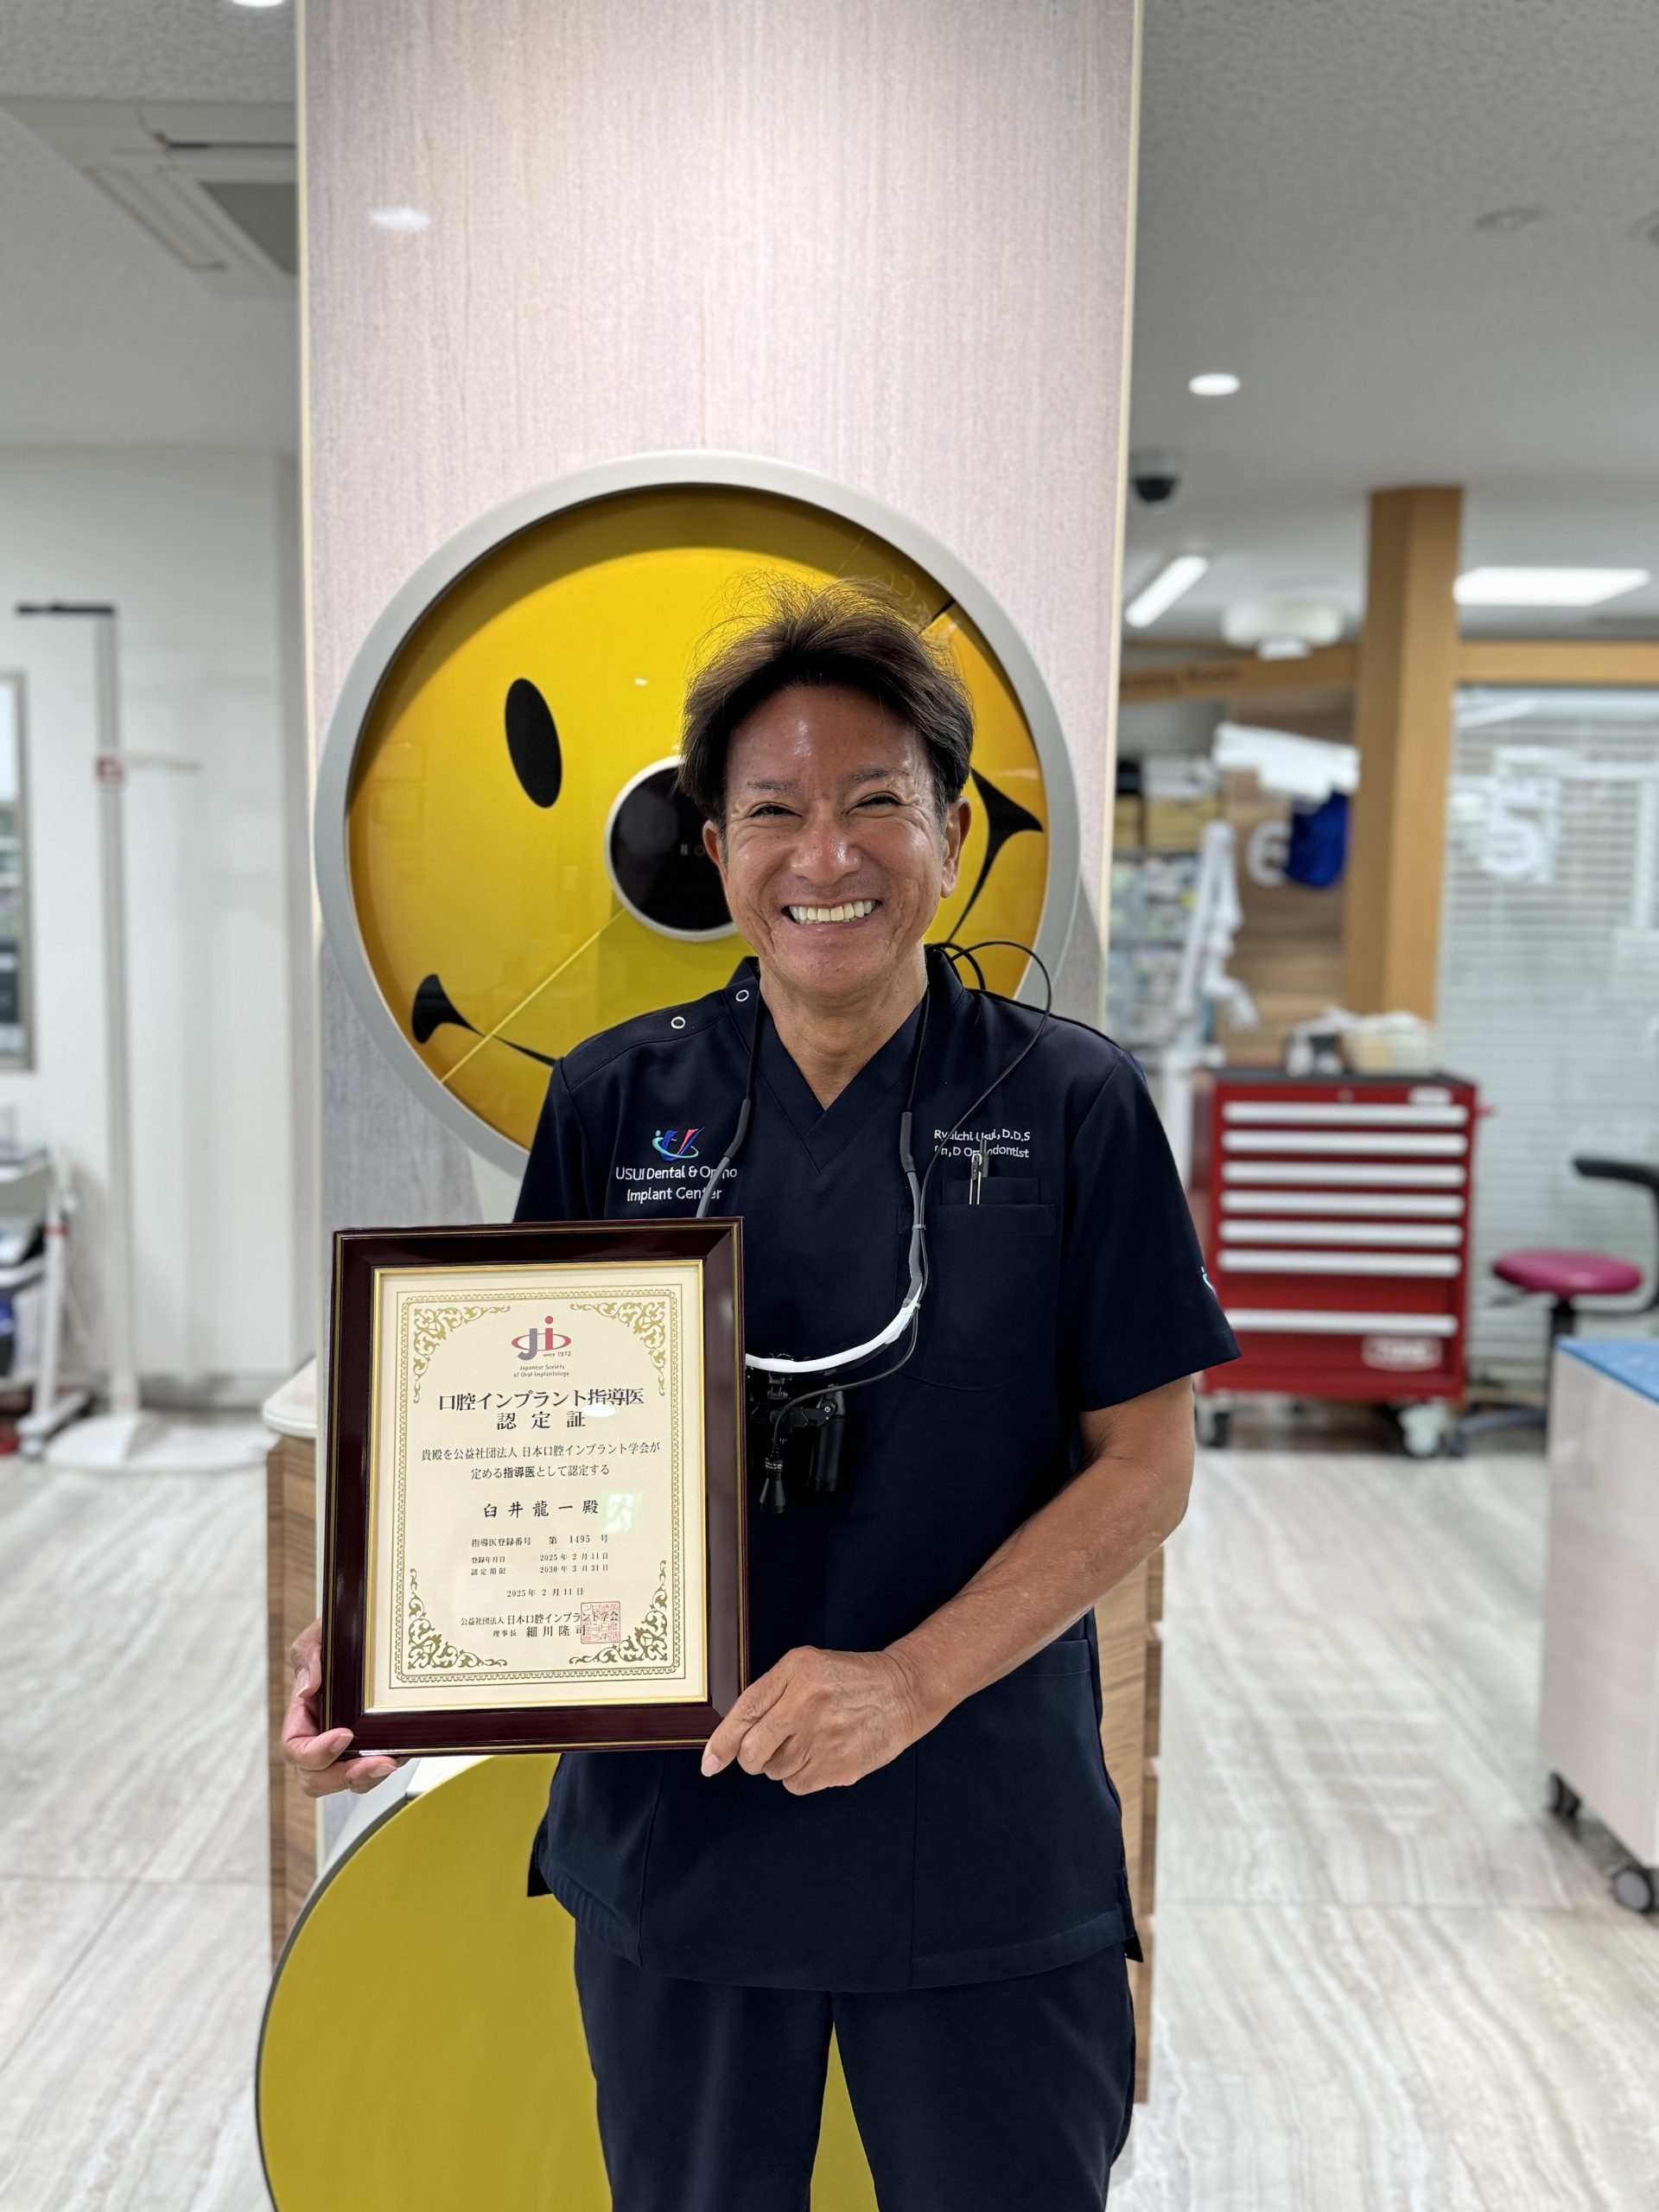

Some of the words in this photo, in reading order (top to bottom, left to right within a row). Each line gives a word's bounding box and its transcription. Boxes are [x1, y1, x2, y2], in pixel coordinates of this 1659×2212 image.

[1001, 1128, 1031, 1141] D.D.S
[963, 1144, 1030, 1158] Orodontist
[615, 1166, 645, 1181] USUI
[646, 1165, 686, 1180] Dental
[688, 1166, 699, 1178] &
[699, 1165, 738, 1179] Orho
[626, 1186, 672, 1205] Implant
[534, 1370, 569, 1378] Implantology
[439, 1388, 645, 1411] 口腔インプラント指導医
[496, 1410, 586, 1430] 認定証
[471, 1464, 610, 1480] 定める指導医として認定する
